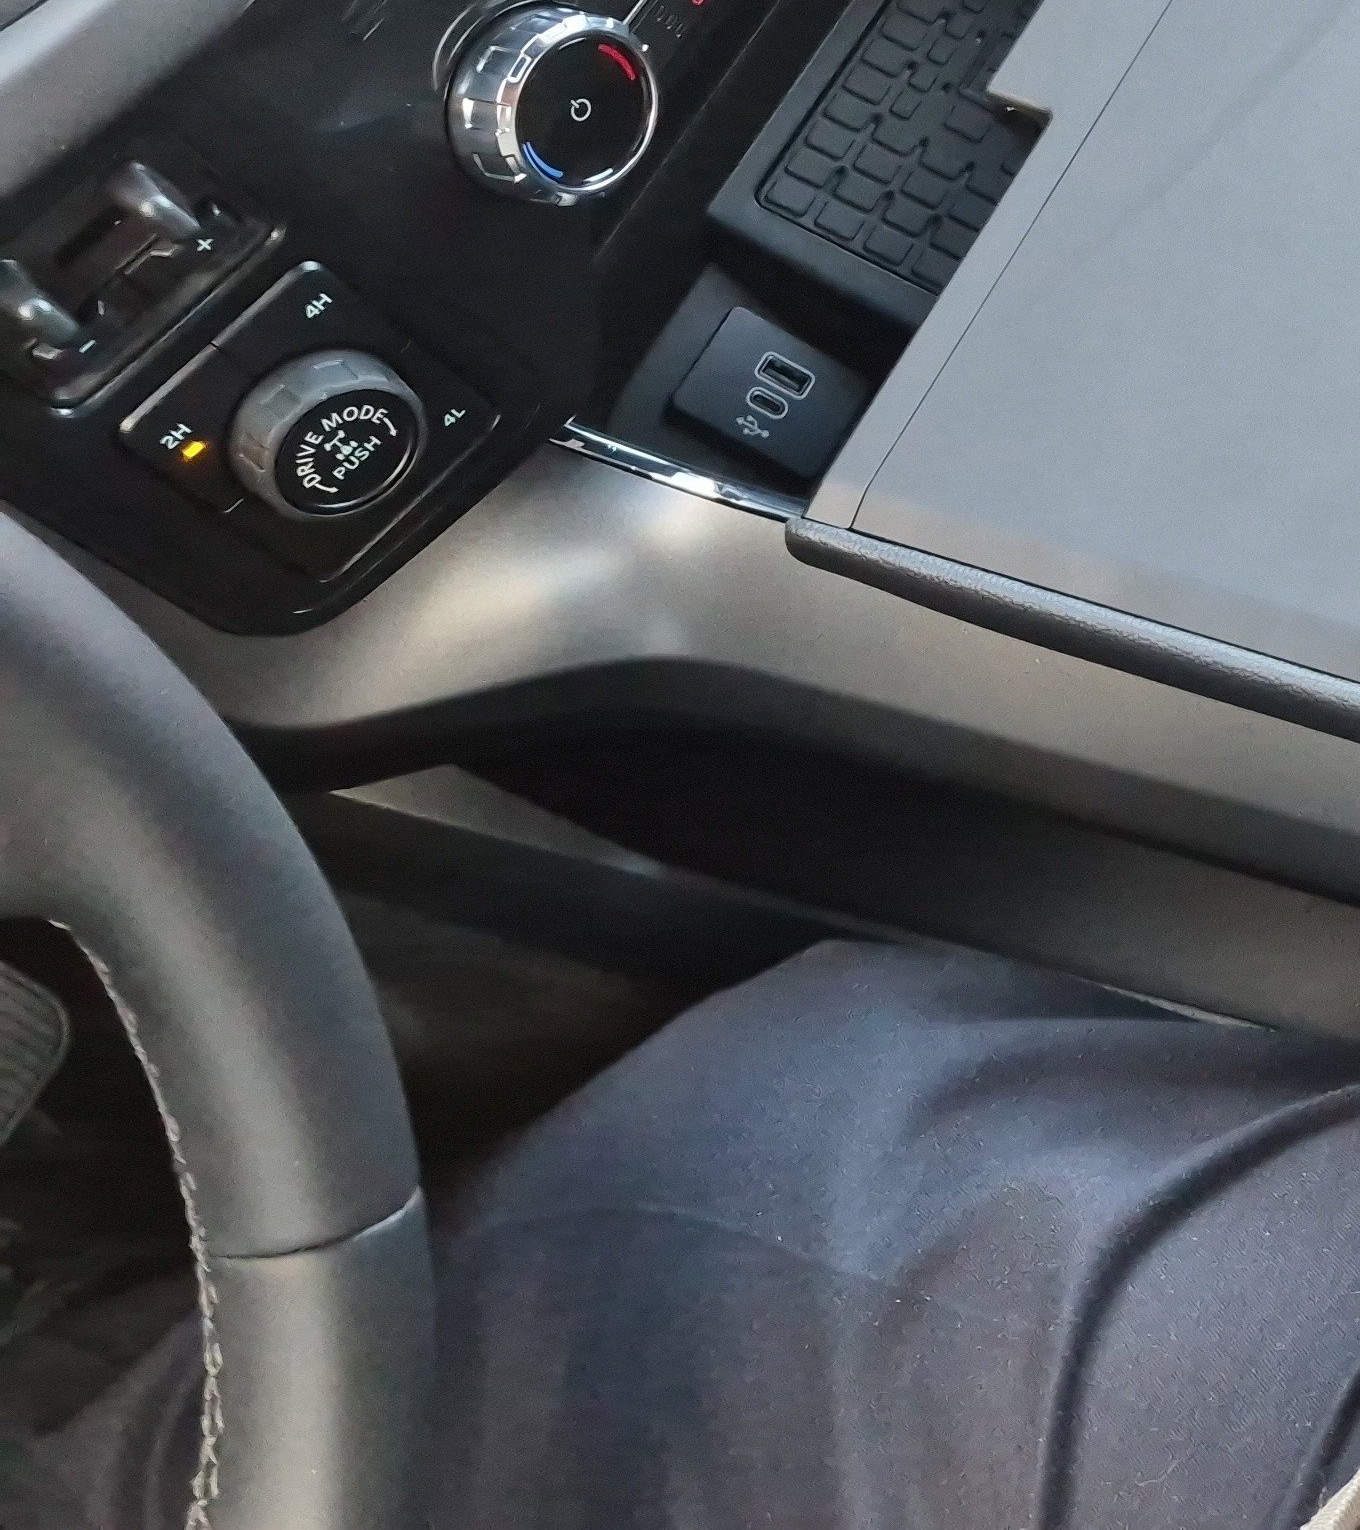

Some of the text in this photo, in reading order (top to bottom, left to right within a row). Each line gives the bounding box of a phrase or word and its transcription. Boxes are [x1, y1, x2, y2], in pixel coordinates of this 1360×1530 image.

[303, 292, 334, 320] 4H
[442, 405, 468, 428] 4L
[159, 423, 193, 450] 2H
[295, 404, 388, 489] DRIVE MODE
[331, 435, 383, 481] PUSH
